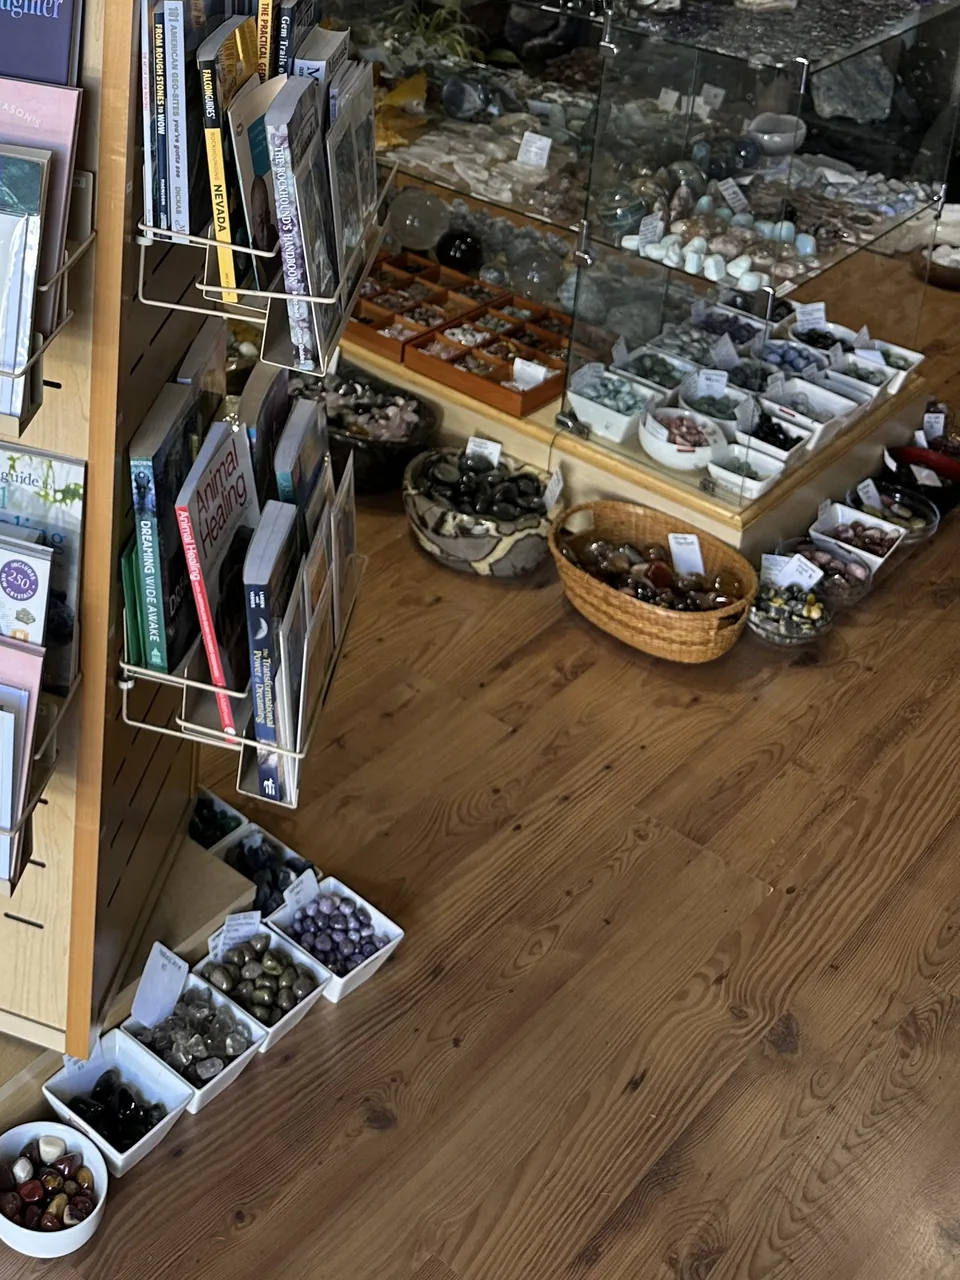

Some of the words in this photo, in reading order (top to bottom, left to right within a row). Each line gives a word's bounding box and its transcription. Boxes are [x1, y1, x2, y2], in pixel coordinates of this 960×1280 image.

[168, 6, 179, 22] 101
[260, 2, 270, 17] THE
[155, 23, 163, 47] FROM
[258, 17, 269, 62] PRACTICAL
[280, 16, 291, 38] Gem
[155, 48, 164, 74] ROUGH
[170, 23, 179, 71] AMERICAN
[278, 39, 289, 66] Trails
[156, 74, 165, 105] STONES
[171, 71, 180, 117] GEO-SITES
[157, 113, 166, 136] WOW
[172, 119, 181, 144] you've
[273, 146, 284, 168] THE
[213, 183, 227, 233] NEVADA
[275, 168, 292, 233] ROCKHOUND'S
[284, 233, 296, 284] HANDBOOK
[0, 470, 40, 488] guide
[42, 476, 53, 491] to
[195, 437, 240, 516] Animal
[200, 470, 248, 560] Healing
[140, 520, 156, 574] DREAMING
[177, 510, 192, 544] Animal
[185, 543, 201, 582] Healing
[0, 571, 9, 591] NEW
[6, 569, 31, 590] 250
[9, 560, 37, 581] INCLUDES
[4, 586, 35, 601] CRYSTALS
[144, 576, 158, 604] WIDE
[146, 604, 161, 643] AWAKE
[253, 649, 263, 677] Power
[254, 682, 265, 725] Dreaming
[263, 656, 276, 729] Transformational
